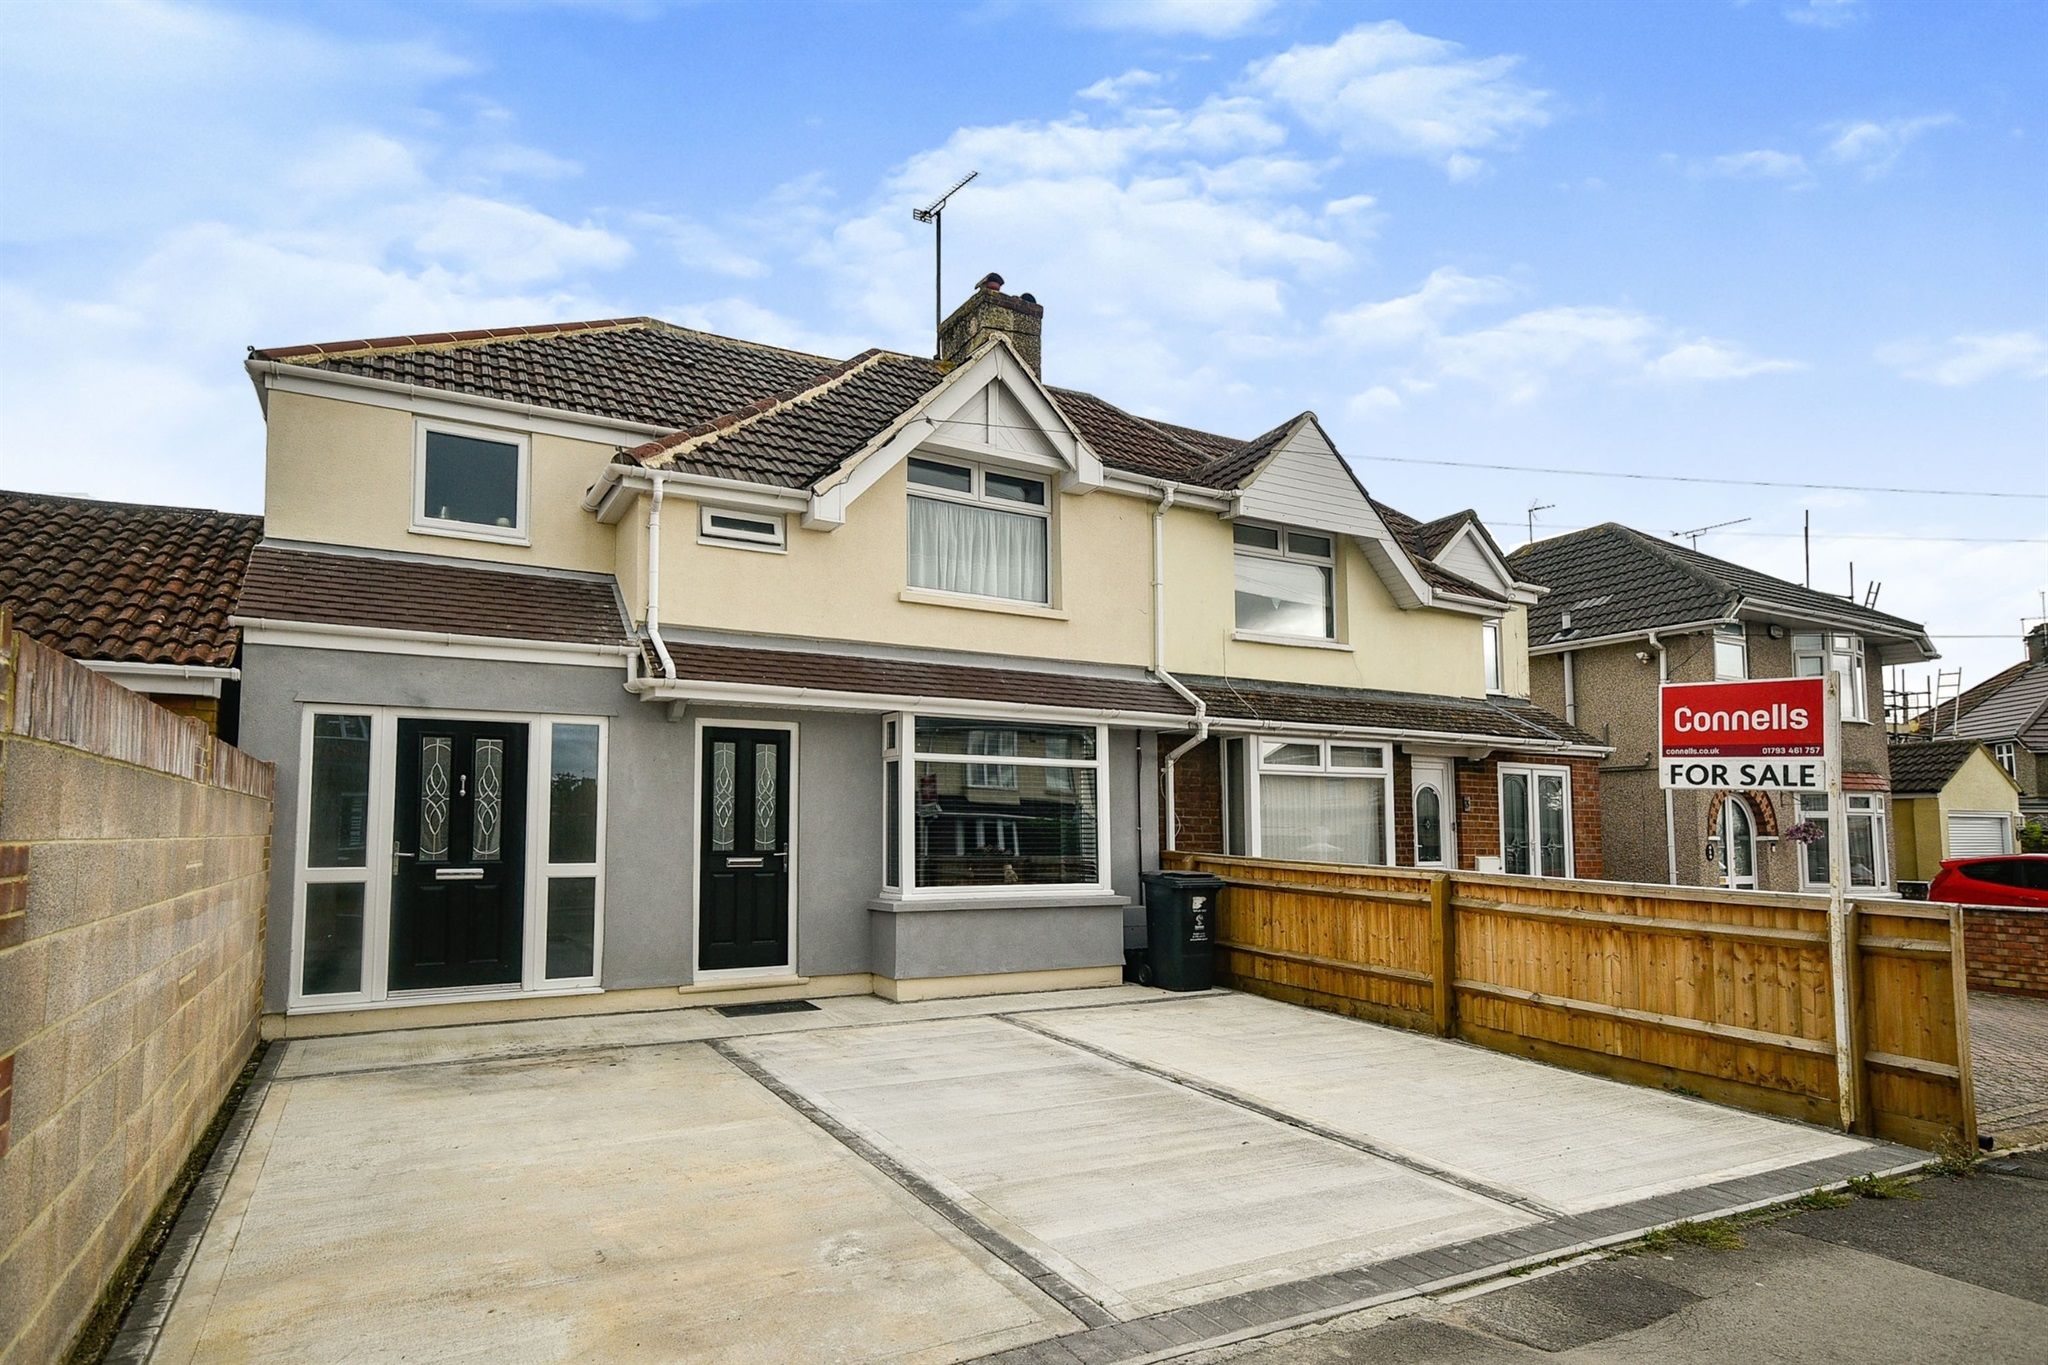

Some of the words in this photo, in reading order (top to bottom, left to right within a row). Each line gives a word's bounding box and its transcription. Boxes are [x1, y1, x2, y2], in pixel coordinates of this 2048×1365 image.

[1674, 703, 1809, 733] Connells
[1665, 747, 1720, 755] connells.co.uk
[1762, 747, 1786, 755] 01793
[1805, 746, 1820, 754] 757
[1670, 764, 1730, 786] FOR
[1739, 764, 1816, 787] SALE
